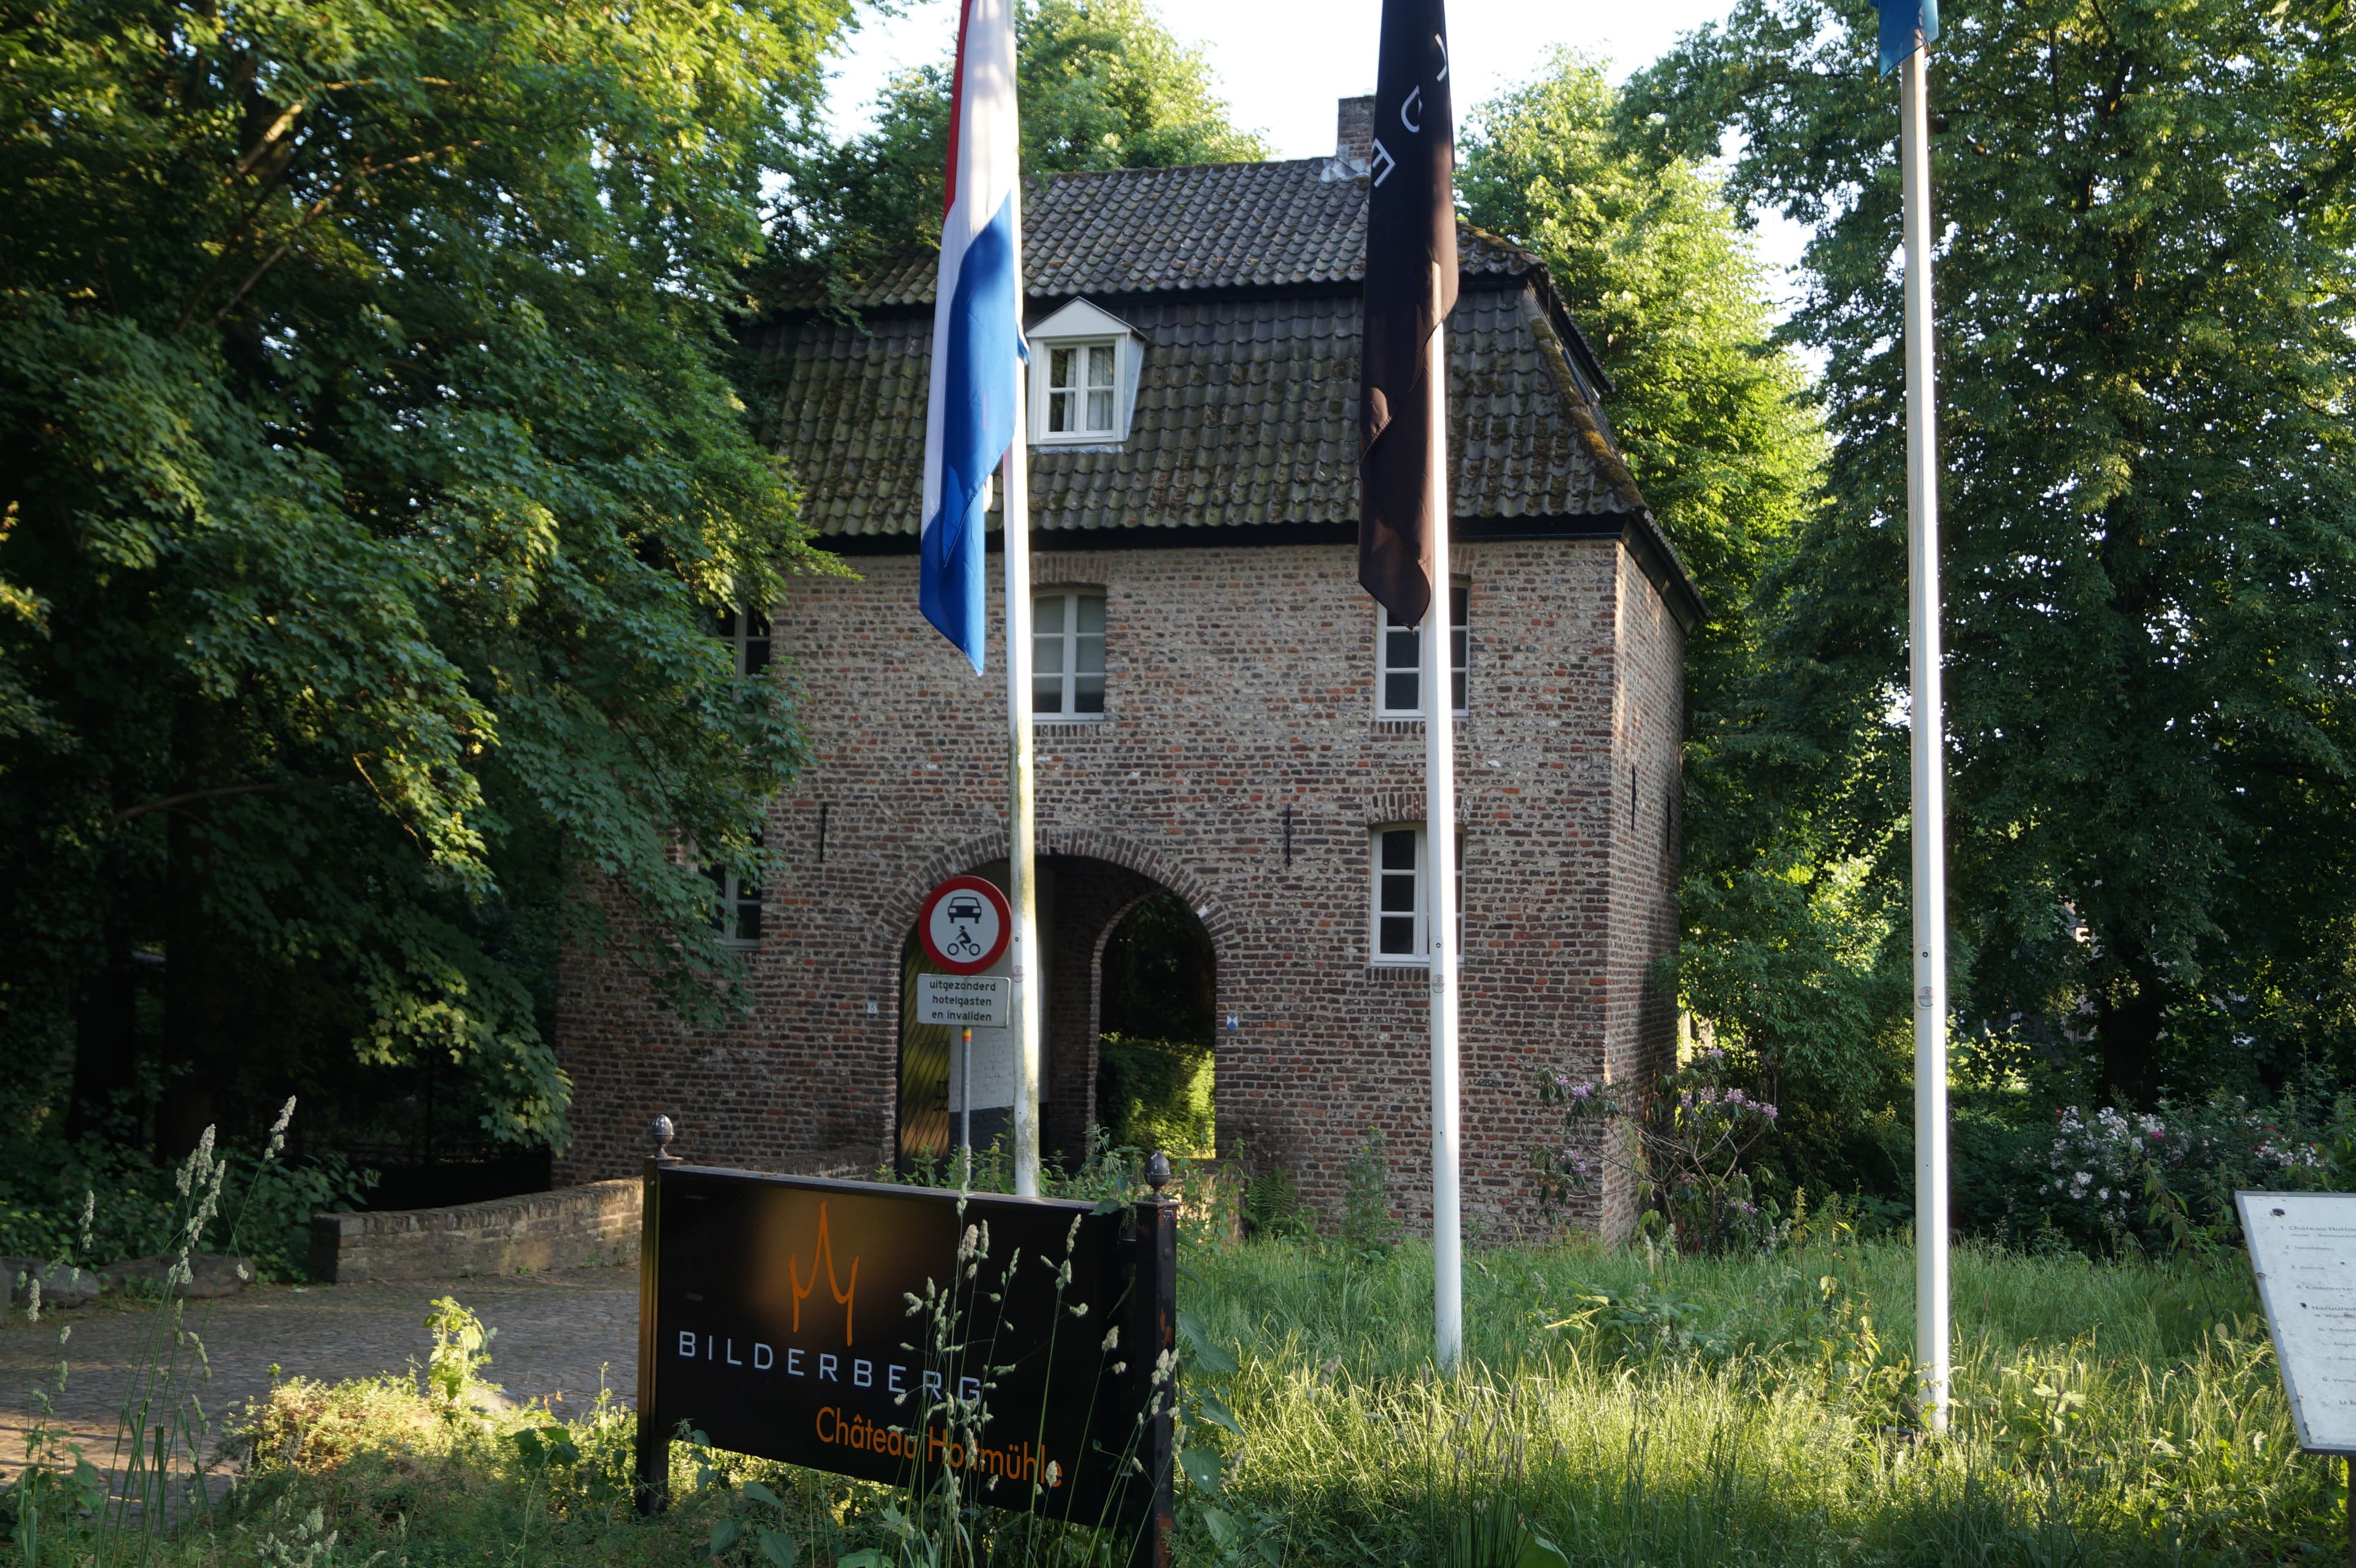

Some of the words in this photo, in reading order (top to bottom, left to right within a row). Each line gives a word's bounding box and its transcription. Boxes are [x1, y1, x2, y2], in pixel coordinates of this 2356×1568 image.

[929, 980, 996, 991] uitgezonderd
[932, 994, 992, 1007] hotelgasten
[947, 1010, 992, 1021] invaliden
[679, 1330, 980, 1407] BILDERBERG
[816, 1406, 918, 1459] Château
